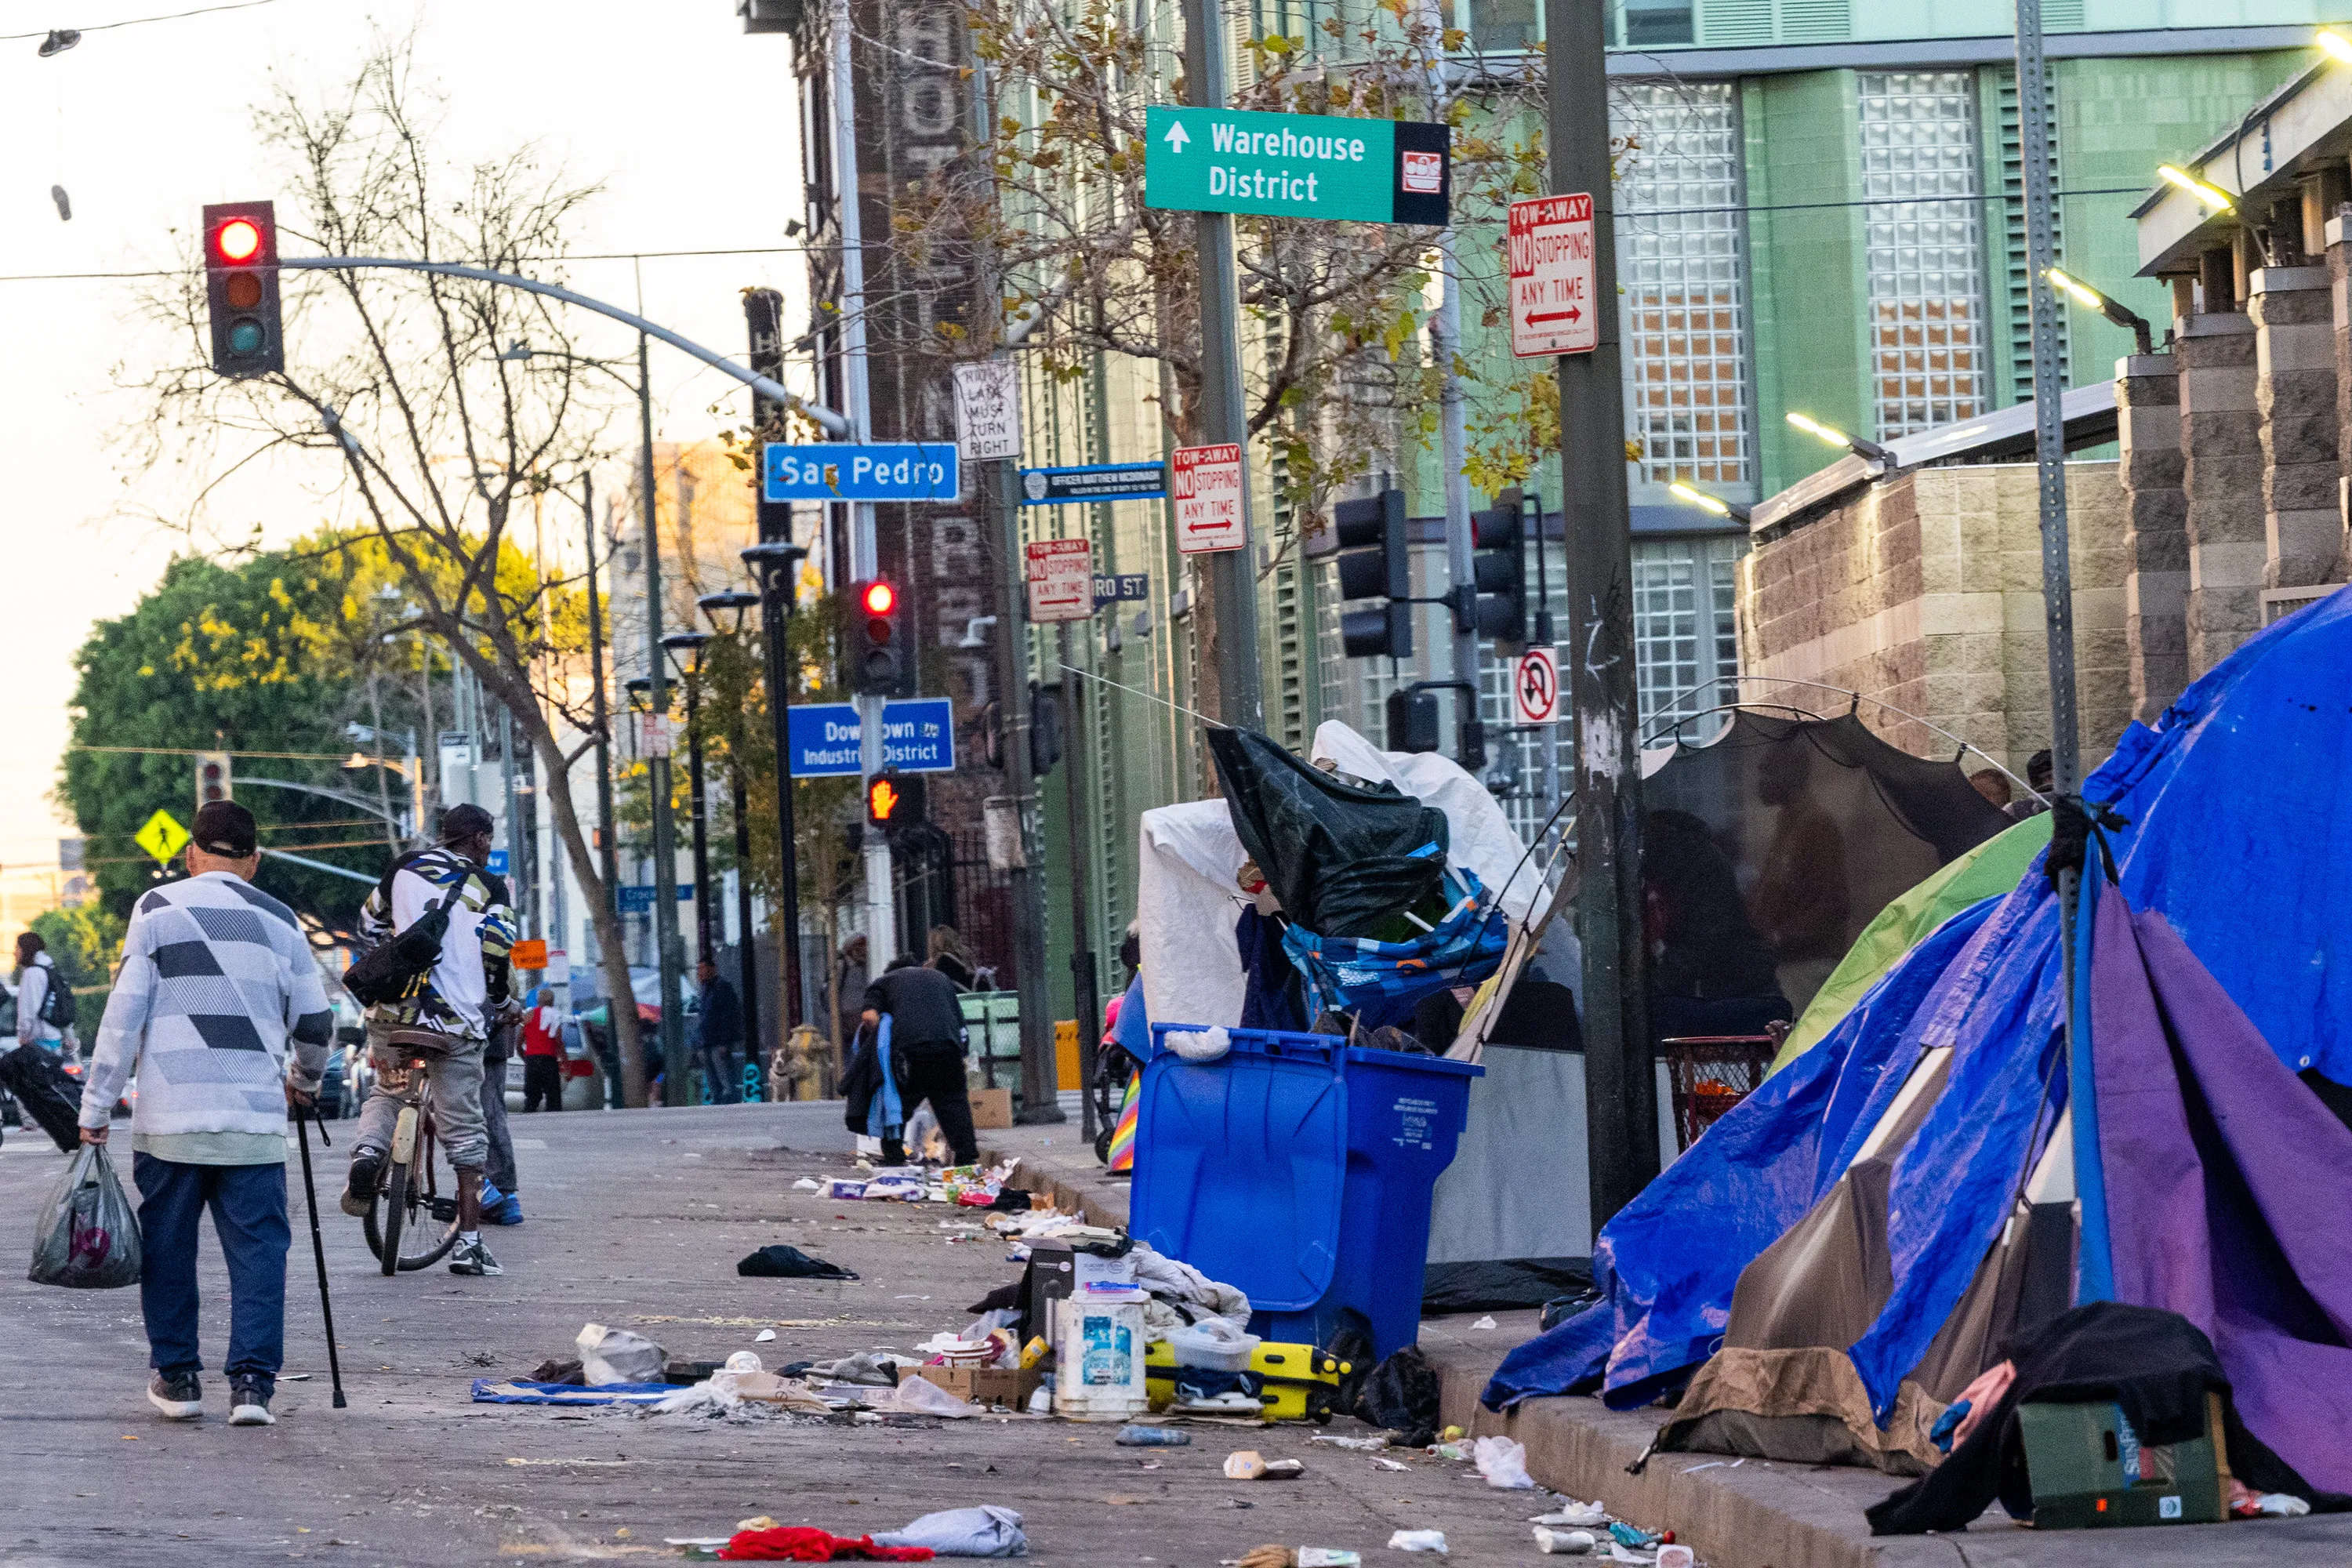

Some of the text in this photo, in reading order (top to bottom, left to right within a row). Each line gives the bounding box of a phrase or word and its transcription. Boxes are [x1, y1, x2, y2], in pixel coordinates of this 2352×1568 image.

[1211, 122, 1366, 162] Warehouse
[1210, 166, 1319, 202] District
[1511, 198, 1589, 226] TOW-AWAY
[1511, 231, 1589, 274] NO STOPPING
[1520, 276, 1584, 307] ANY TIME
[971, 423, 1006, 437] TURN
[970, 439, 1009, 455] RIGHT
[1176, 447, 1238, 466] TOW-AWAY
[781, 456, 944, 485] San Pedro
[1175, 470, 1194, 497] NO
[1196, 470, 1239, 491] STOPPING
[1184, 499, 1235, 518] ANY TIME
[1029, 558, 1045, 579] NO
[825, 720, 915, 742] Dowown
[804, 744, 938, 765] Industri District
